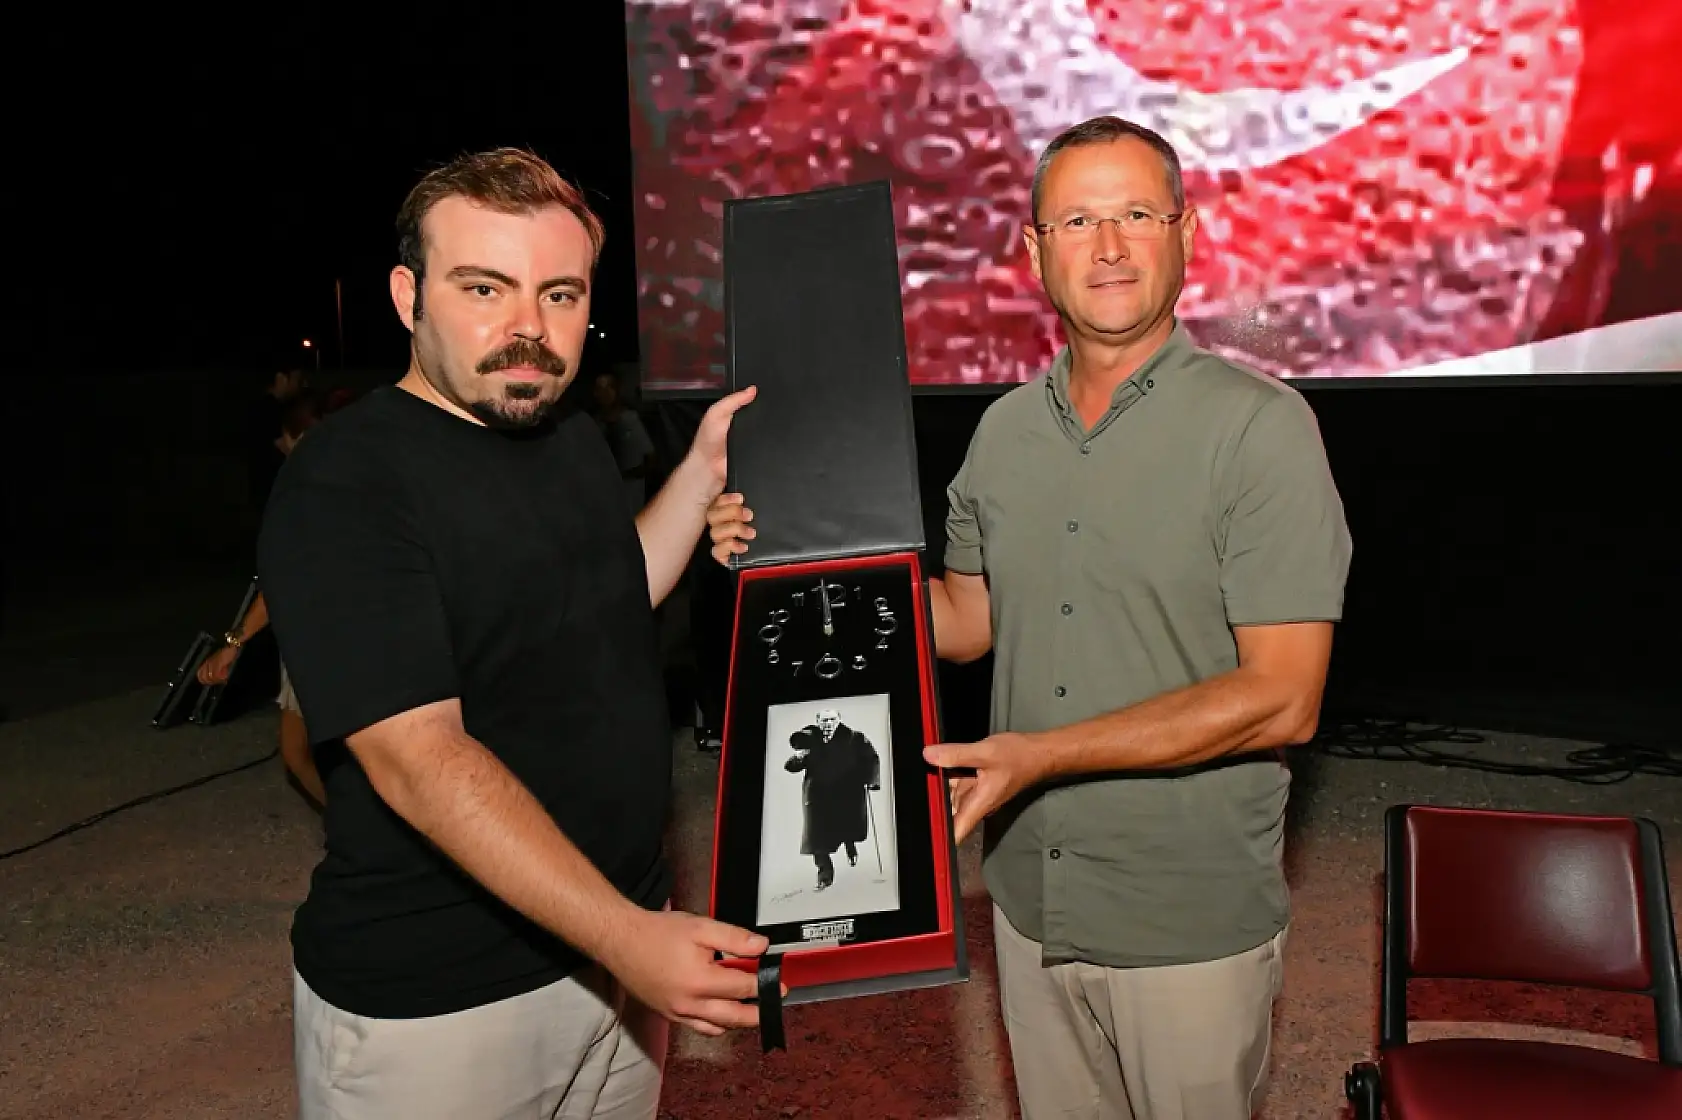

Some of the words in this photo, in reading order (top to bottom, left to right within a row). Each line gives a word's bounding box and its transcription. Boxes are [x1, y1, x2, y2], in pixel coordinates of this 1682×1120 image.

[791, 592, 805, 607] 11
[853, 585, 862, 600] 1
[768, 608, 790, 625] 10
[758, 624, 784, 649] 9
[874, 636, 889, 653] 4
[768, 649, 780, 664] 8
[791, 660, 804, 677] 7
[814, 652, 843, 680] 6
